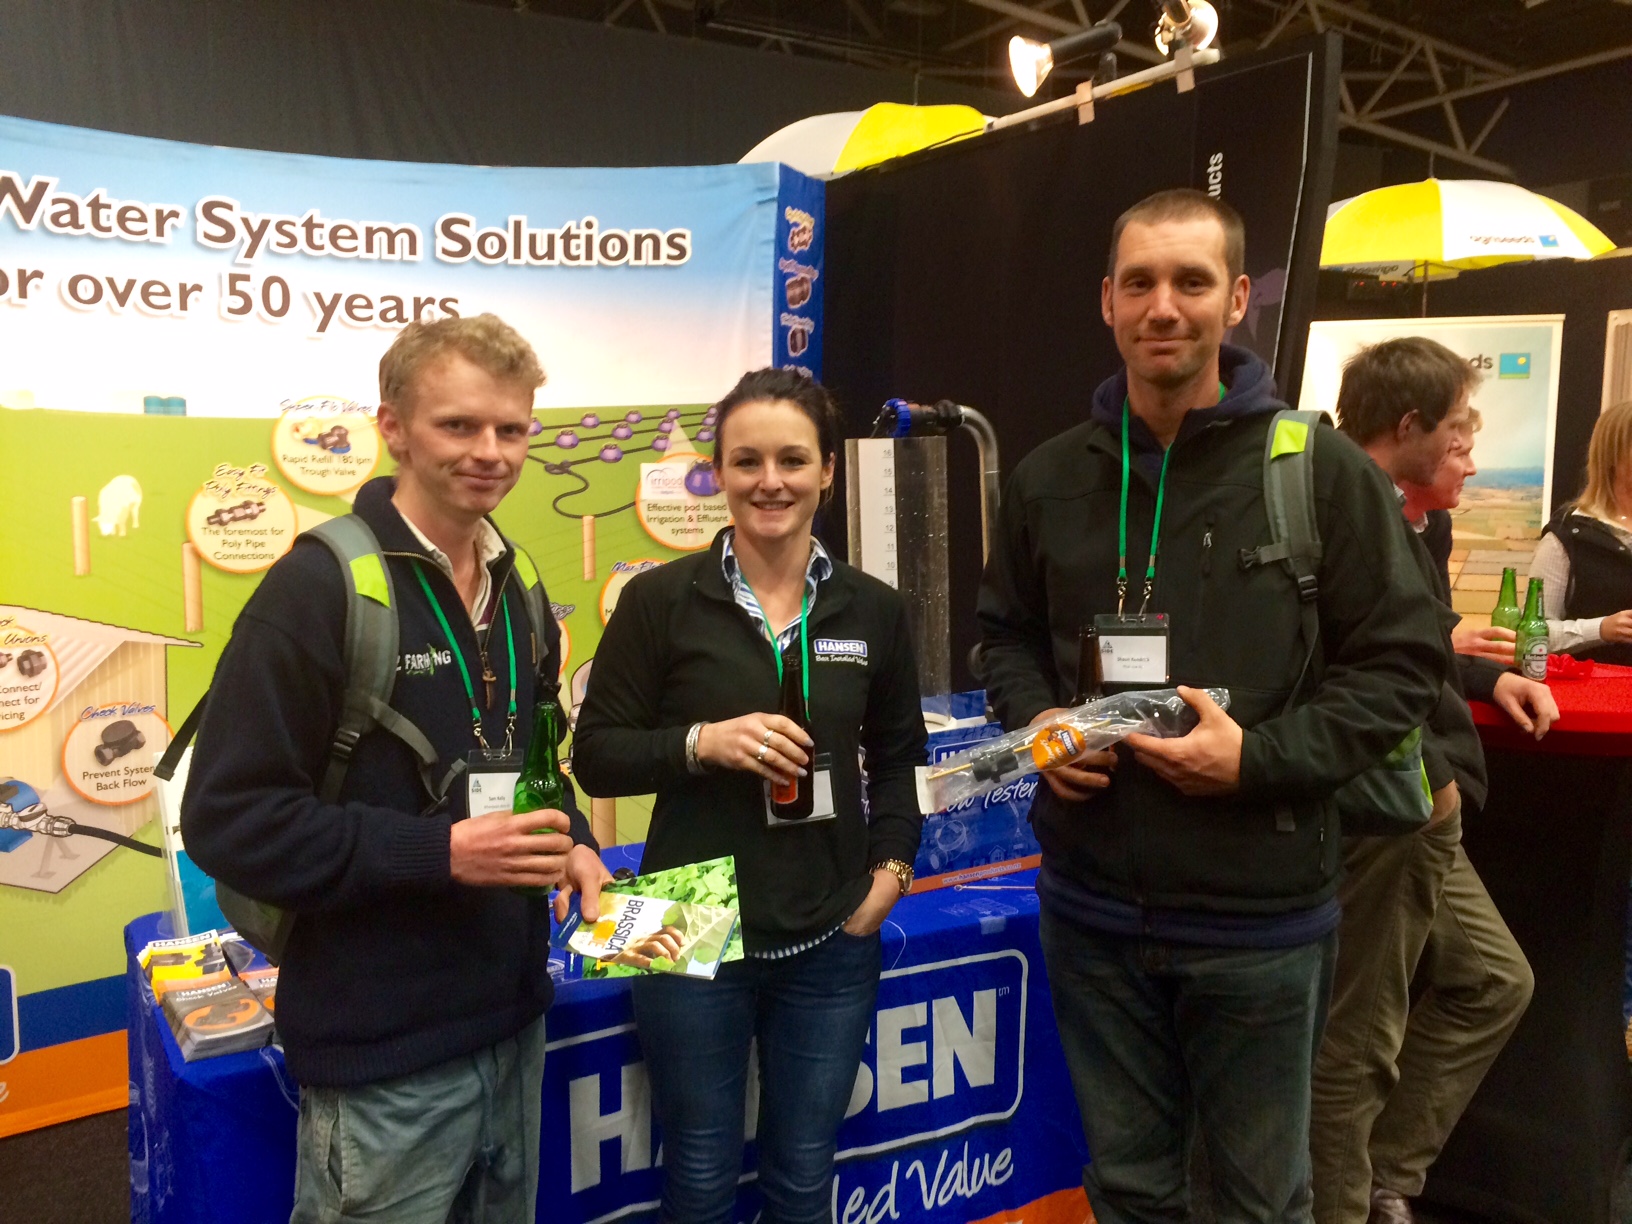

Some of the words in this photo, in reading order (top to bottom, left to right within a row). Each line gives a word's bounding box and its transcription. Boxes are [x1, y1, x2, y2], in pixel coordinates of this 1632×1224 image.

[0, 176, 180, 238] Water
[201, 200, 418, 259] System
[441, 216, 689, 262] Solutions
[67, 274, 203, 311] over
[227, 273, 290, 318] 50
[313, 291, 460, 333] years
[300, 466, 331, 477] Trough
[334, 466, 357, 476] Valve
[647, 503, 681, 511] Effective
[684, 503, 700, 513] pod
[703, 502, 727, 511] based
[647, 514, 685, 525] Irrigation
[697, 514, 728, 523] Effluent
[201, 527, 220, 535] The
[223, 526, 268, 536] foremost
[270, 526, 284, 536] for
[671, 527, 704, 536] systems
[222, 539, 242, 550] Poly
[245, 539, 266, 549] Pipe
[213, 551, 275, 560] Connections
[4, 633, 47, 645] Unions
[817, 641, 864, 654] HANSEN
[24, 695, 40, 705] for
[81, 705, 118, 719] Check
[122, 702, 156, 716] Valves
[82, 769, 120, 780] Prevent
[96, 781, 120, 791] Back
[123, 778, 147, 788] Flow
[604, 899, 645, 954] BRASSICA
[154, 933, 212, 948] HANSEN
[181, 982, 228, 996] HANSEN
[906, 1141, 1014, 1210] Value
